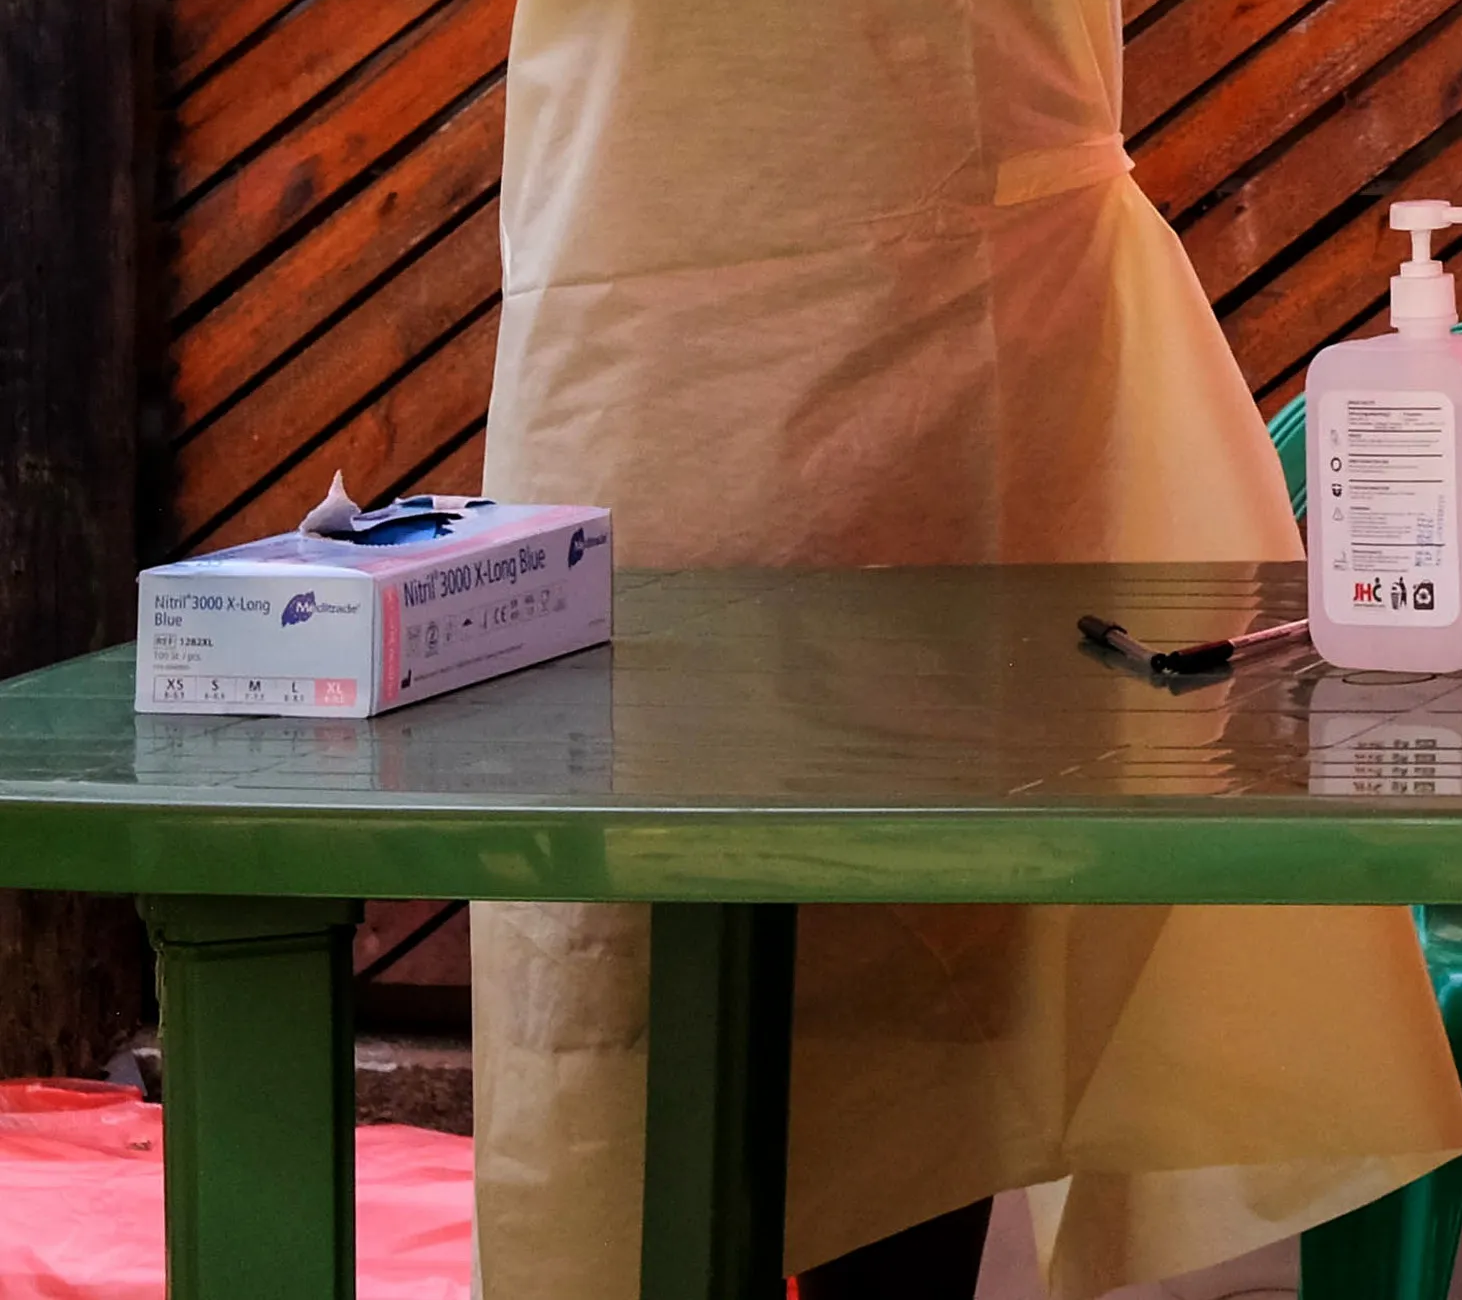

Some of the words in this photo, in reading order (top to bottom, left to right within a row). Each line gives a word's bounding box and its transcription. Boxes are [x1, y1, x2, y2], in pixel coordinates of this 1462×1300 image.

[440, 565, 471, 598] 3000
[474, 556, 517, 587] X-Long
[519, 546, 546, 574] Blue
[1353, 582, 1383, 602] JHC
[192, 596, 223, 611] 3000
[226, 597, 271, 617] X-Long
[154, 611, 183, 628] Blue
[166, 679, 184, 690] XS
[211, 679, 220, 691] S
[249, 680, 262, 692] M
[291, 681, 299, 693] L
